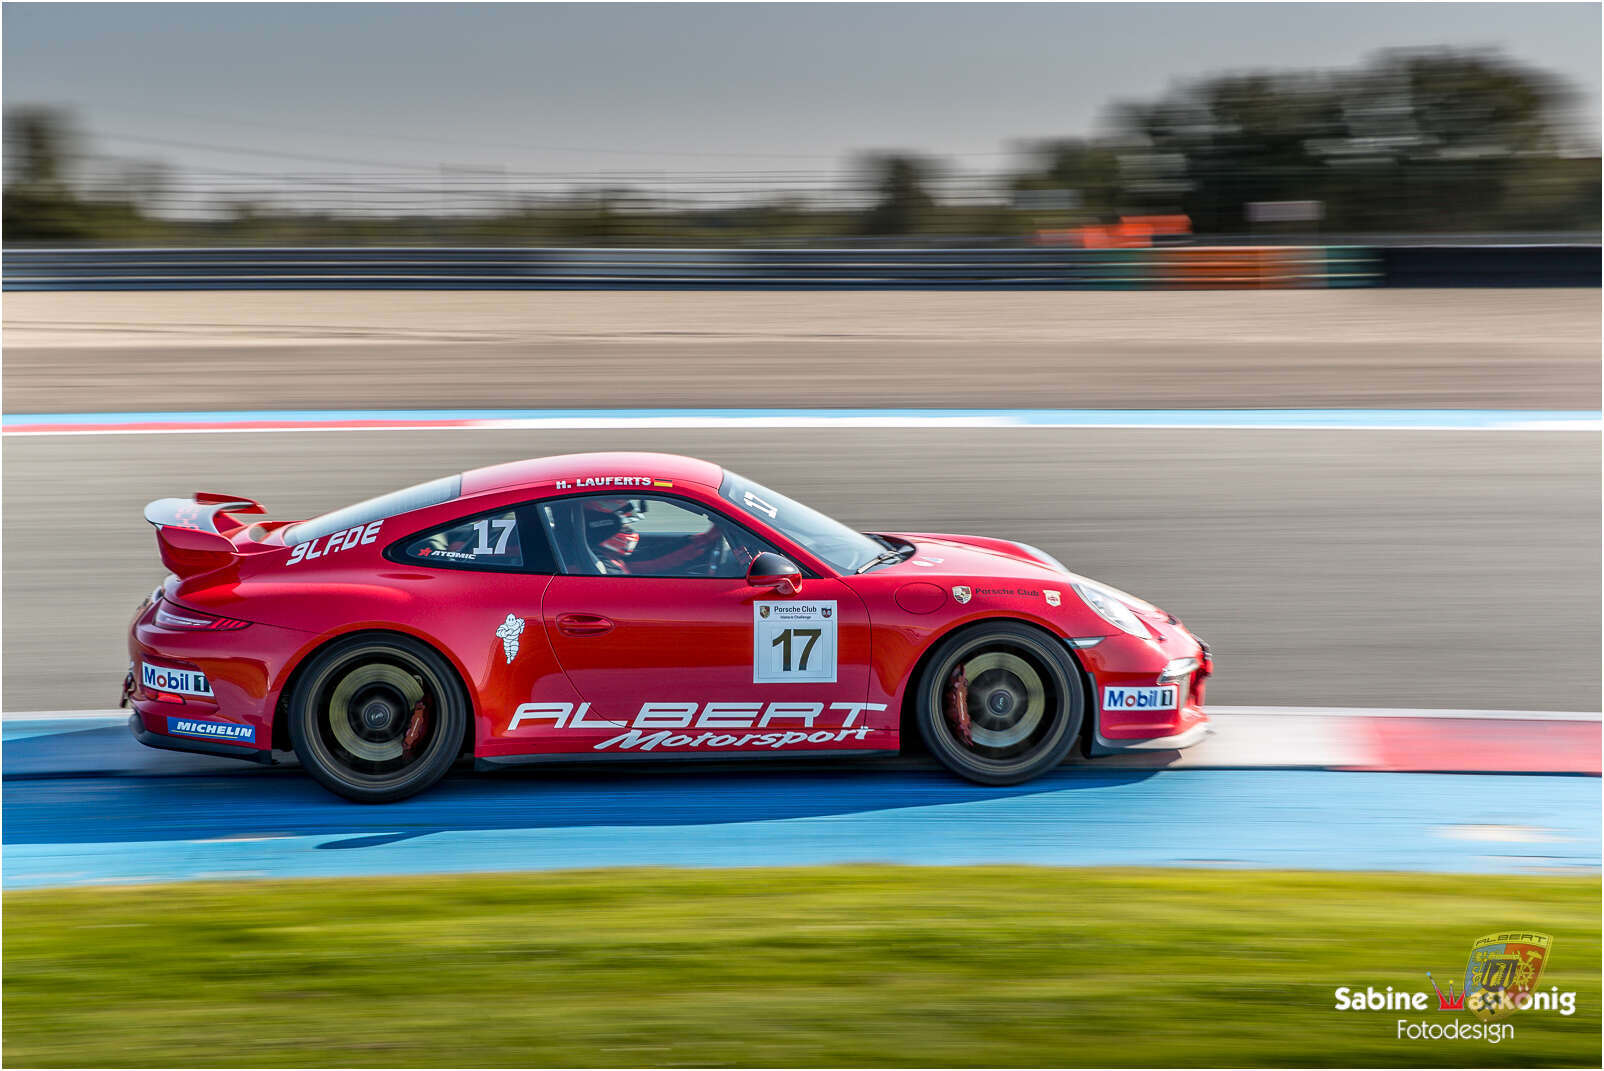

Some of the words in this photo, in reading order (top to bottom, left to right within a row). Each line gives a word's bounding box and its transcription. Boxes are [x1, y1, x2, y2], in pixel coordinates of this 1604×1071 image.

[556, 480, 572, 489] H.
[576, 476, 652, 487] LAUFERTS
[473, 520, 517, 554] 17
[431, 550, 476, 560] ATOMIC
[772, 629, 821, 671] 17
[144, 666, 189, 690] Mobil
[1108, 690, 1158, 707] Mobil
[508, 702, 888, 730] ALBERT
[177, 721, 252, 737] MICHELIN
[594, 727, 874, 750] Motorsport
